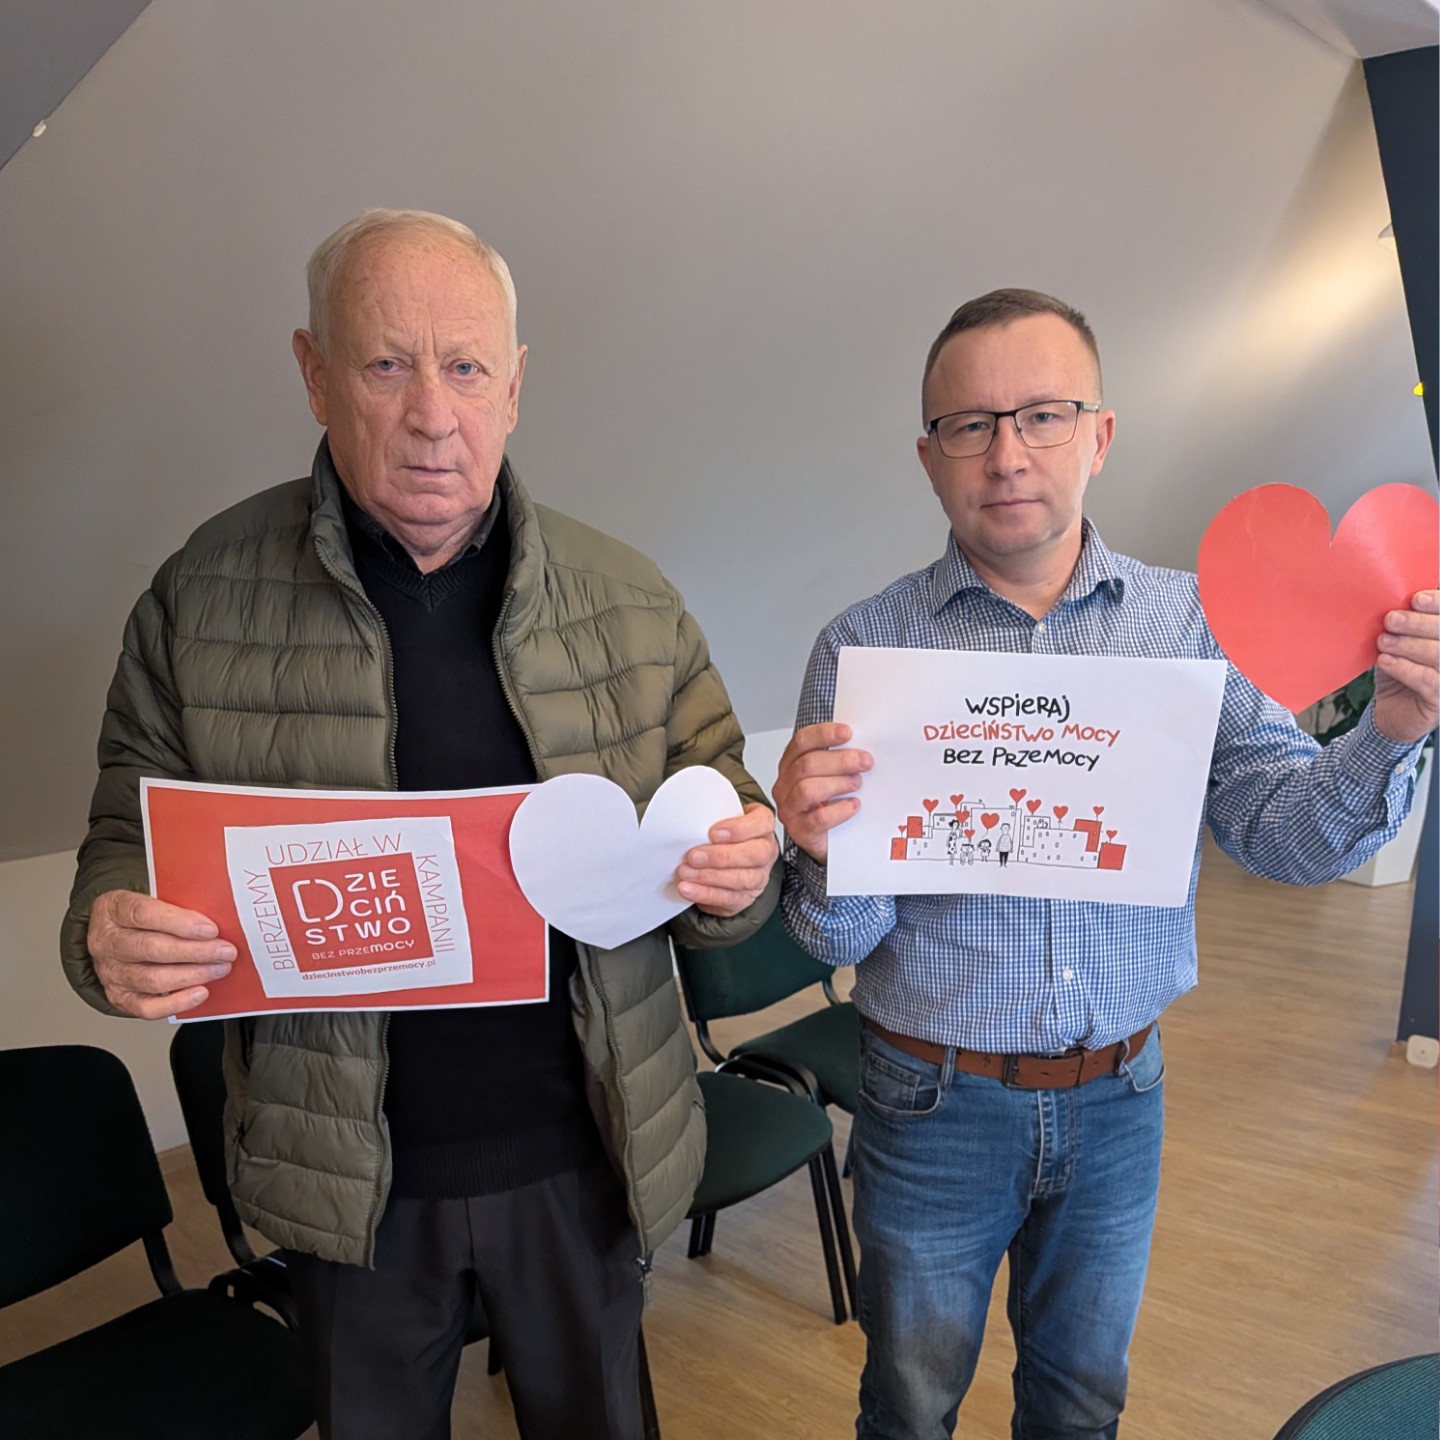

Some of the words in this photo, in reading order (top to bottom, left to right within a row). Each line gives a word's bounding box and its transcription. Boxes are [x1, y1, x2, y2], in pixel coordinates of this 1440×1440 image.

[264, 837, 368, 866] UDZIAŁ
[372, 832, 402, 853] W
[416, 854, 456, 953] KAMPANII
[243, 868, 295, 972] BIERZEMY
[304, 917, 412, 946] STWO
[311, 951, 336, 960] BEZ
[338, 939, 415, 958] PRZEMOCY
[302, 960, 436, 981] dziecinstwobezprzemocy.pl
